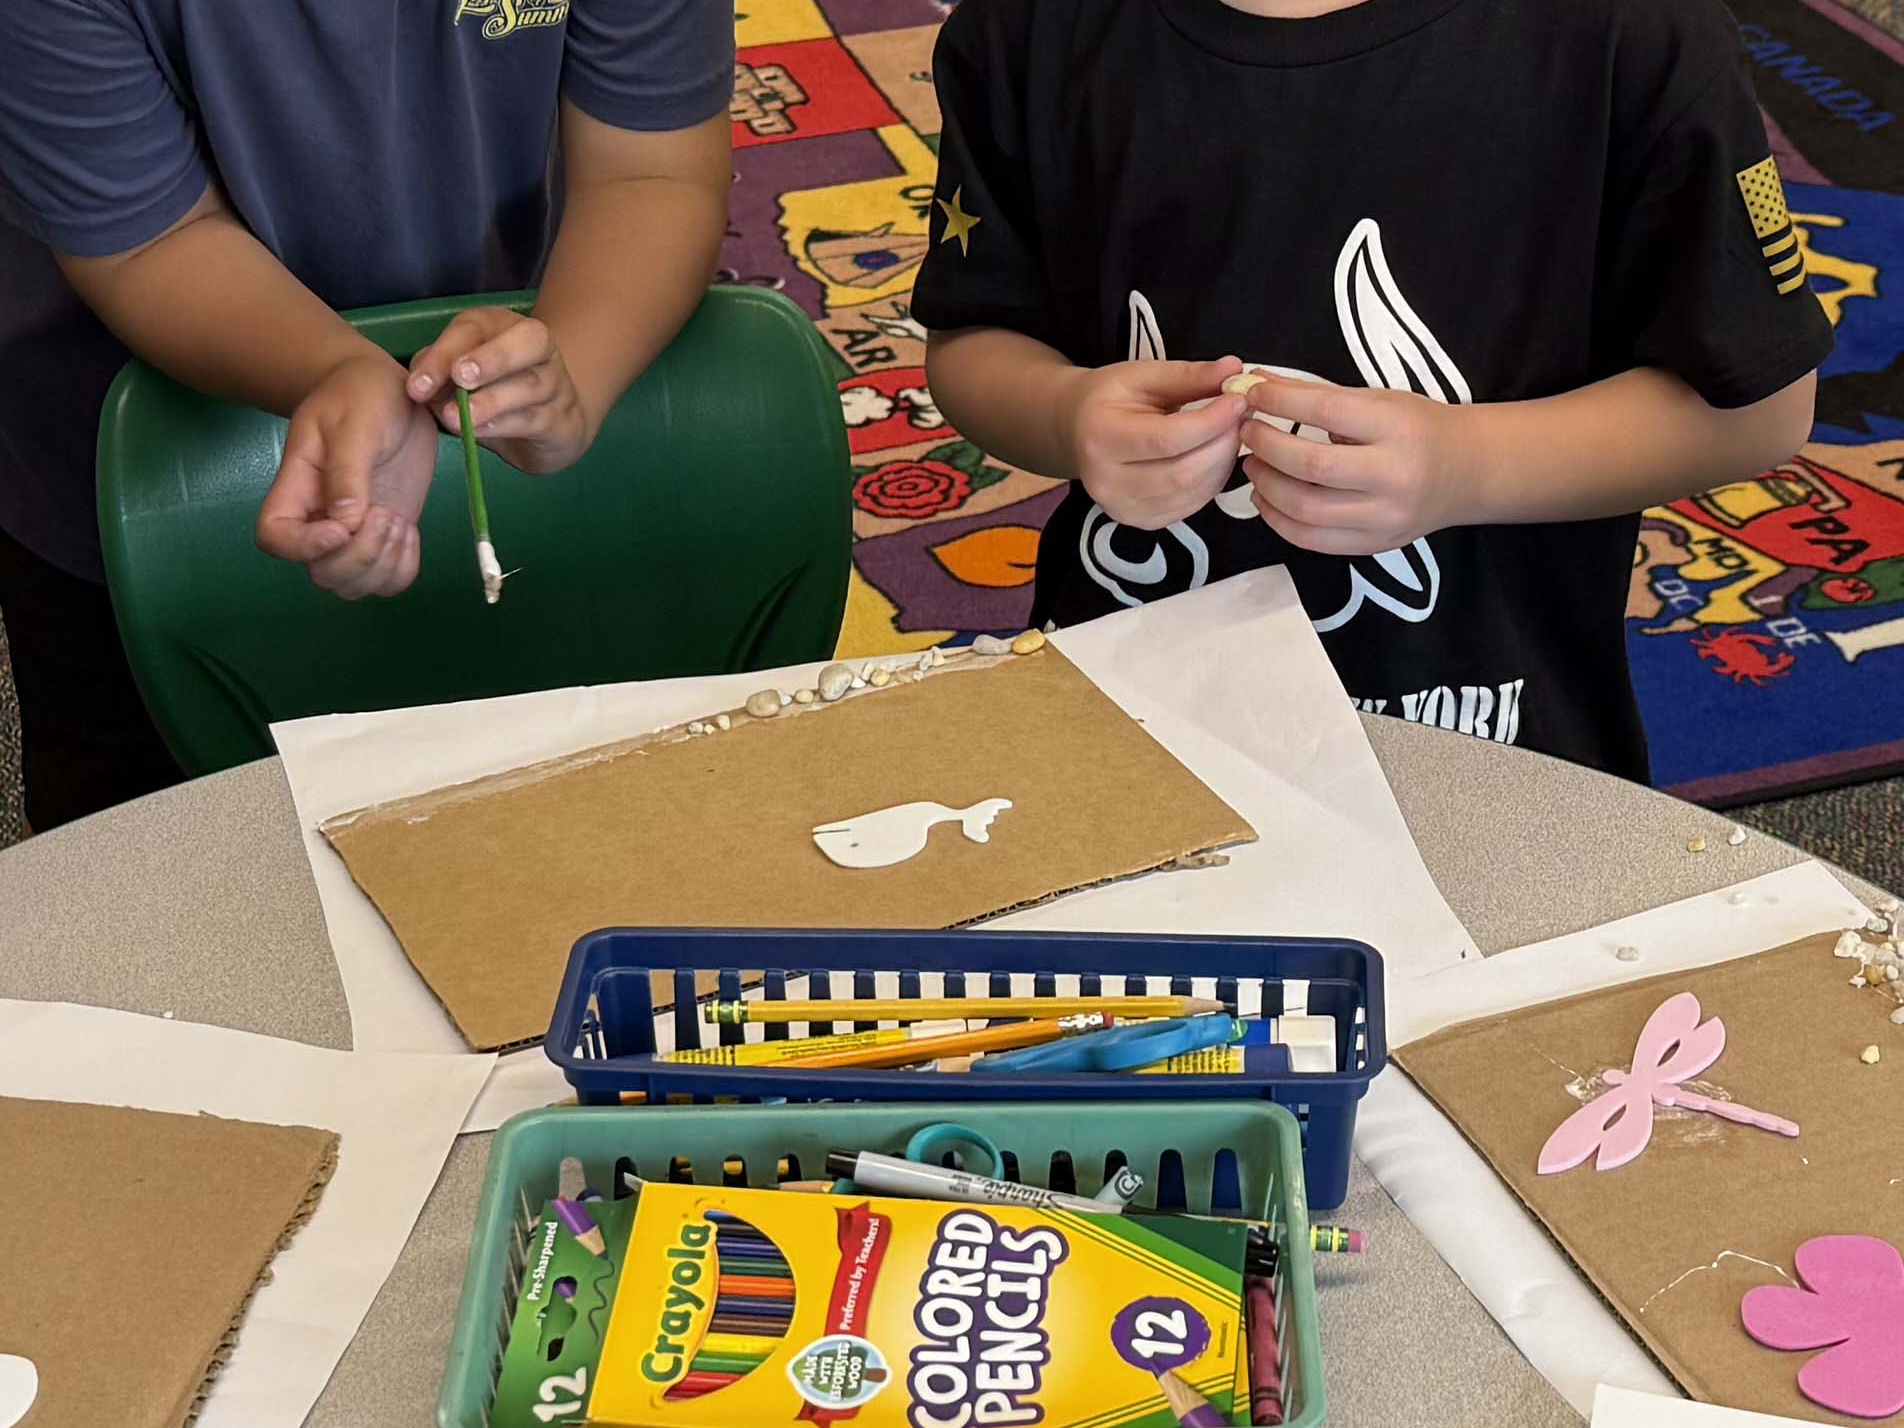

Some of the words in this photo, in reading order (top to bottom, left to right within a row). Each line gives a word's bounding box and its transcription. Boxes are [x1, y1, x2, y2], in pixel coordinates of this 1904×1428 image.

[1738, 24, 1896, 132] CANADA
[830, 329, 896, 368] AR
[1694, 538, 1749, 569] MD
[1788, 516, 1871, 565] PA
[1655, 579, 1704, 610] DC
[1766, 617, 1822, 649] DE
[528, 1222, 558, 1300] Pre-Sharpened
[850, 1266, 867, 1281] by
[641, 1224, 710, 1382] Crayola
[840, 1280, 861, 1330] Preferred
[974, 1230, 1063, 1424] PENCILS
[1132, 1309, 1187, 1359] 12
[533, 1367, 587, 1422] 12
[819, 1356, 833, 1384] WITH
[848, 1356, 862, 1389] WOOD
